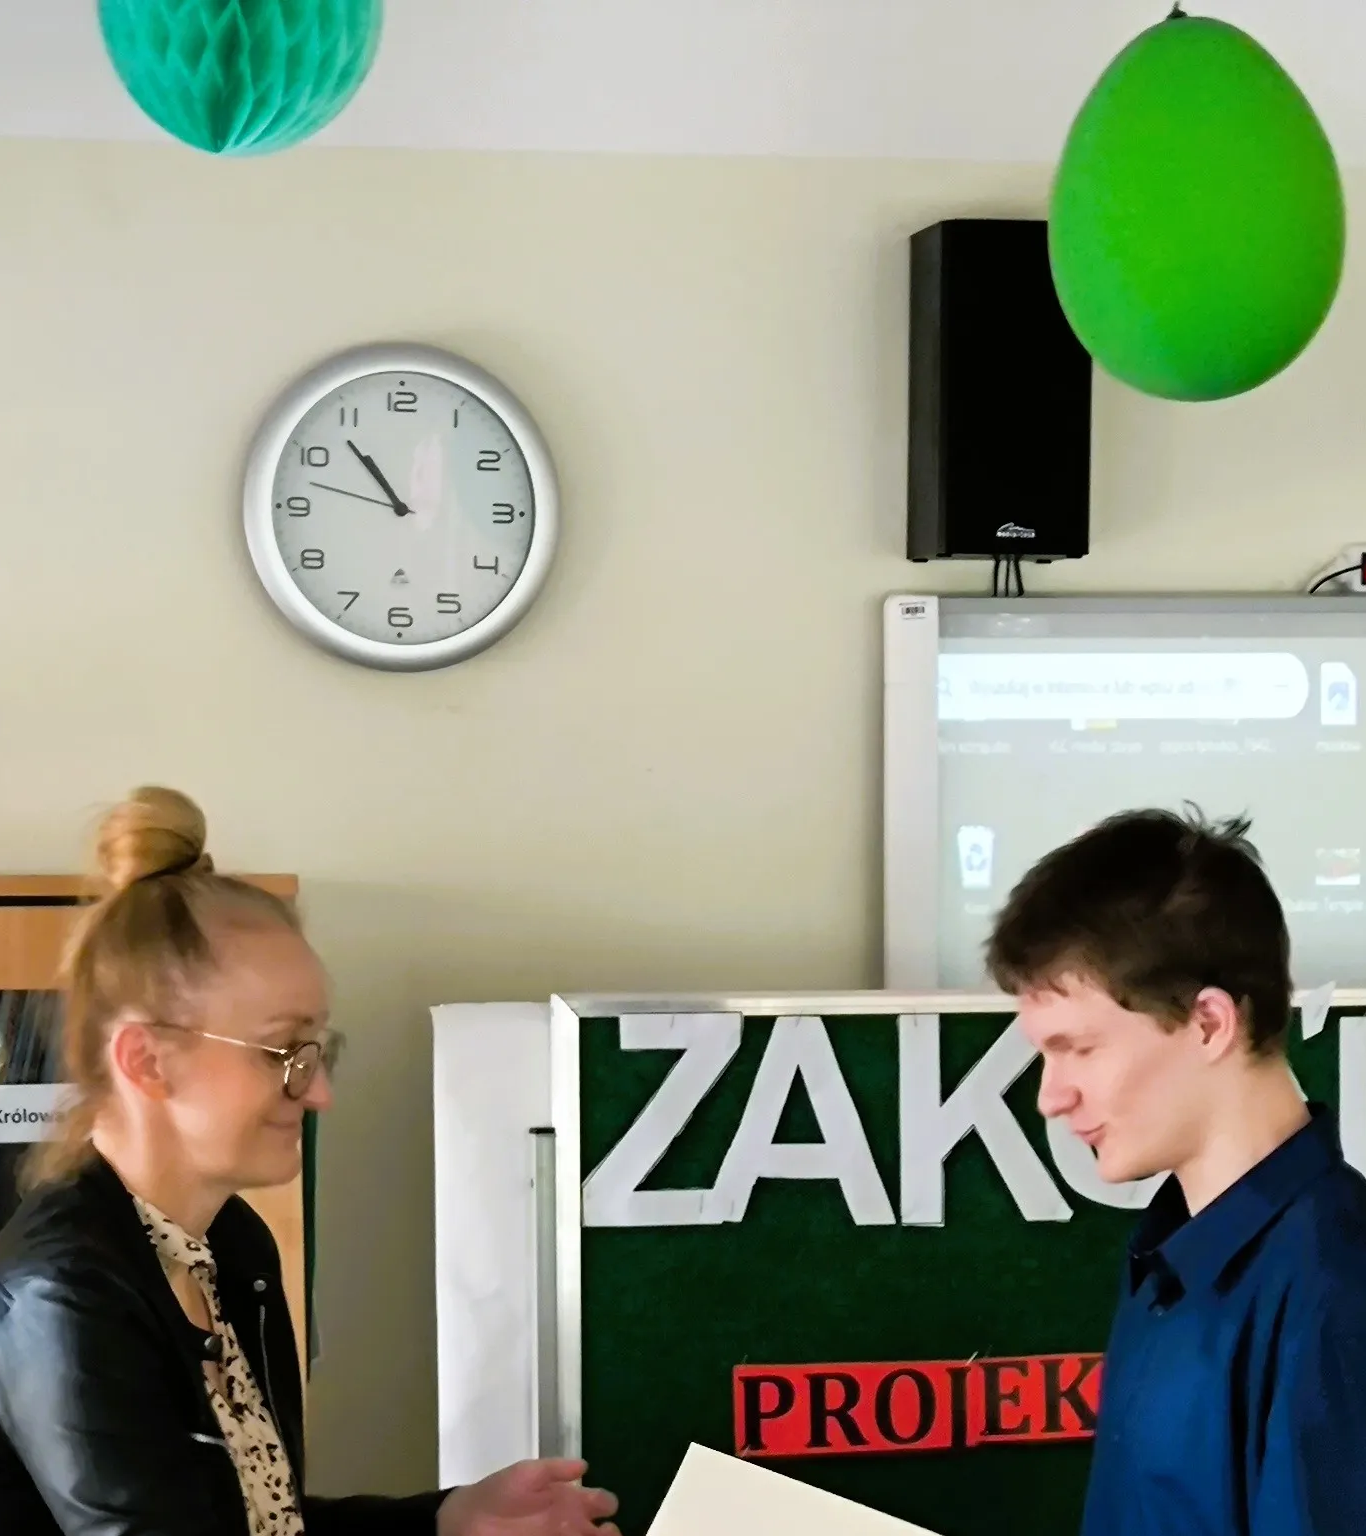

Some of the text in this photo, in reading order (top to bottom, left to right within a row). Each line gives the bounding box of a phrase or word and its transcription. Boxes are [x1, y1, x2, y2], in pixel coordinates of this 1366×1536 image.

[386, 391, 419, 413] 12
[338, 408, 359, 428] 11
[300, 446, 329, 467] 10
[476, 450, 501, 472] 2
[286, 497, 311, 518] 9
[492, 503, 514, 524] 3
[300, 548, 324, 570] 8
[473, 556, 499, 575] 4
[337, 591, 360, 612] 7
[436, 593, 462, 615] 5
[387, 606, 413, 628] 6
